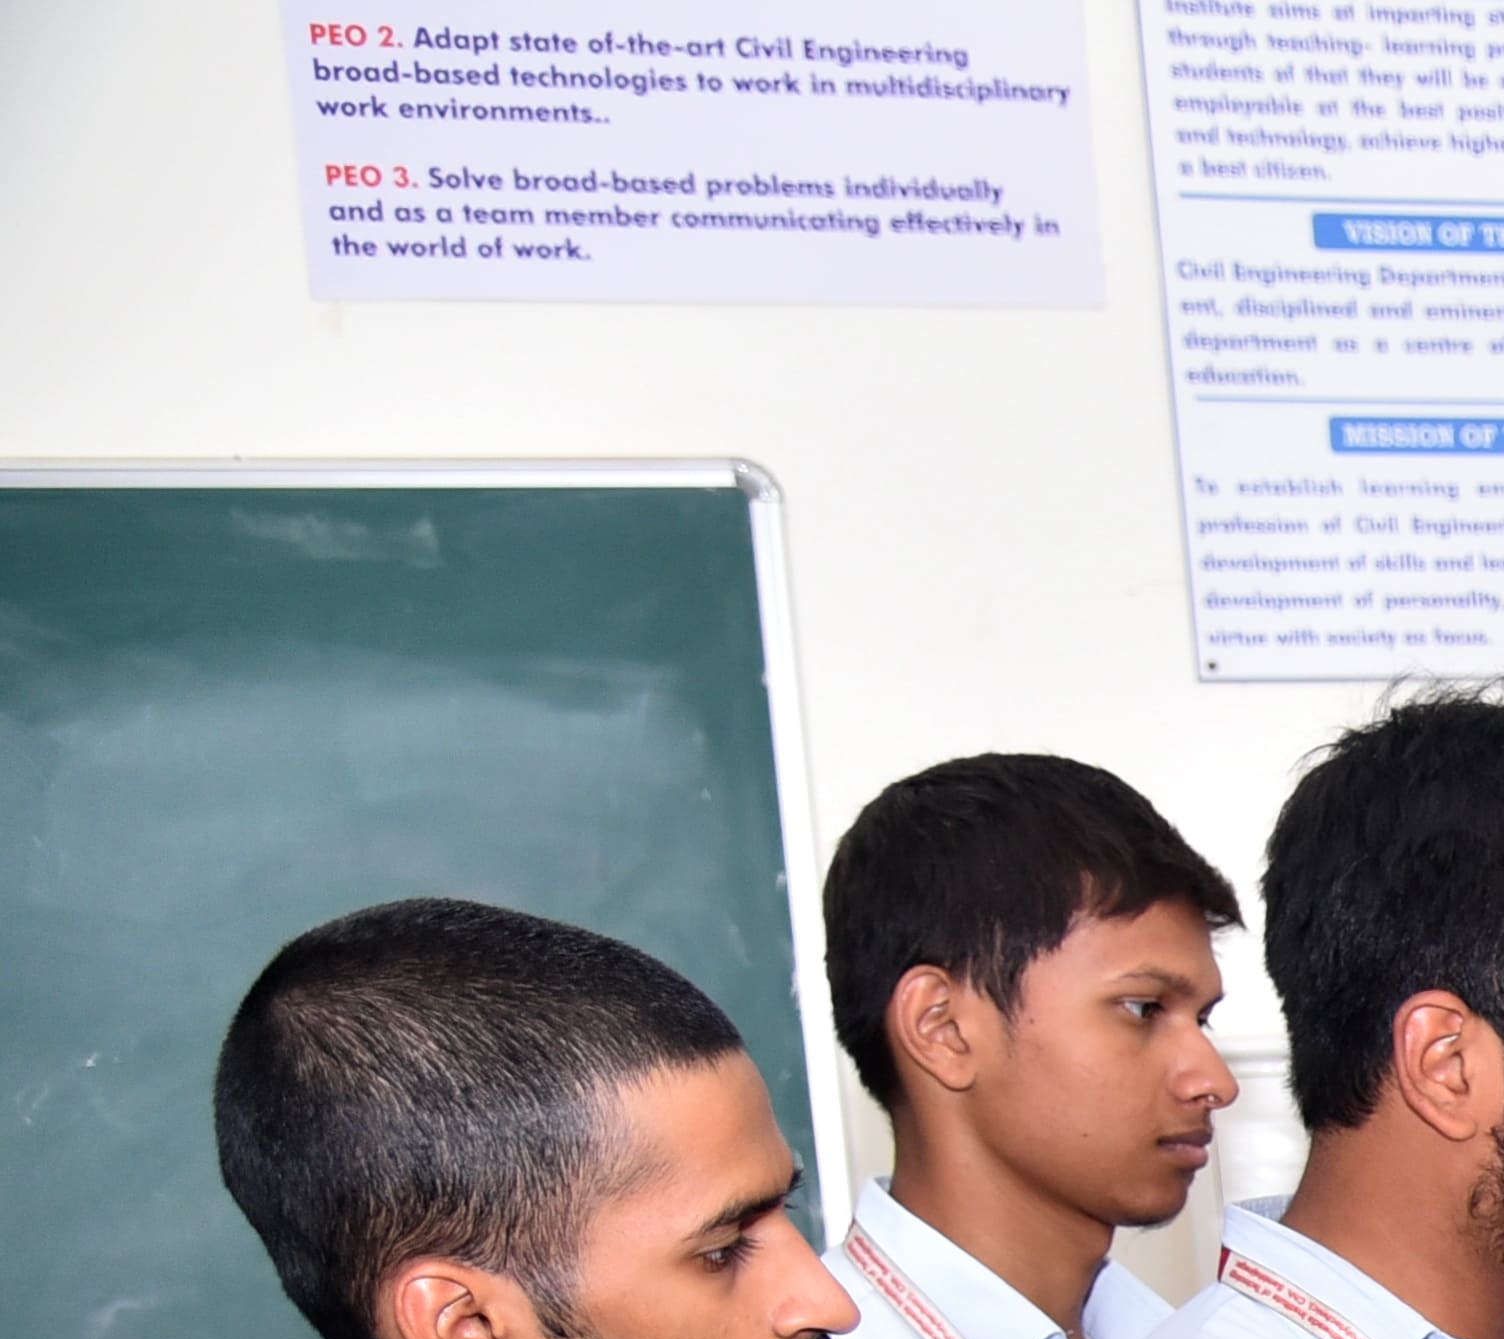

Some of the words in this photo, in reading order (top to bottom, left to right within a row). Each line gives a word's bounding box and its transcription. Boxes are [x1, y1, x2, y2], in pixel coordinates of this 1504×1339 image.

[309, 23, 368, 47] PEO
[377, 25, 404, 49] 2.
[413, 26, 500, 57] Adapt
[509, 32, 578, 54] state
[735, 36, 793, 59] Civil
[802, 39, 969, 72] Engineering
[312, 57, 501, 86] broad-based
[509, 64, 688, 97] technologies
[696, 72, 723, 93] to
[731, 71, 800, 95] work
[811, 73, 836, 94] in
[845, 75, 1070, 106] multidisciplinary
[316, 94, 389, 118] work
[325, 164, 383, 188] PEO
[393, 166, 419, 189] 3.
[428, 166, 504, 191] Solve
[512, 167, 697, 195] broad-based
[705, 173, 836, 201] problems
[844, 177, 1003, 206] individually
[328, 199, 384, 222] and
[394, 206, 427, 224] as
[435, 207, 454, 224] a
[462, 204, 535, 225] team
[544, 204, 660, 228] member
[670, 210, 881, 238] communicating
[889, 211, 1025, 239] effectively
[1034, 217, 1060, 235] in
[1342, 219, 1433, 246] VISION
[1437, 222, 1475, 247] OF
[332, 233, 378, 257] the
[386, 235, 467, 259] world
[477, 236, 503, 259] of
[512, 237, 591, 260] work.
[1343, 423, 1455, 448] MISSION
[1460, 424, 1498, 449] OF
